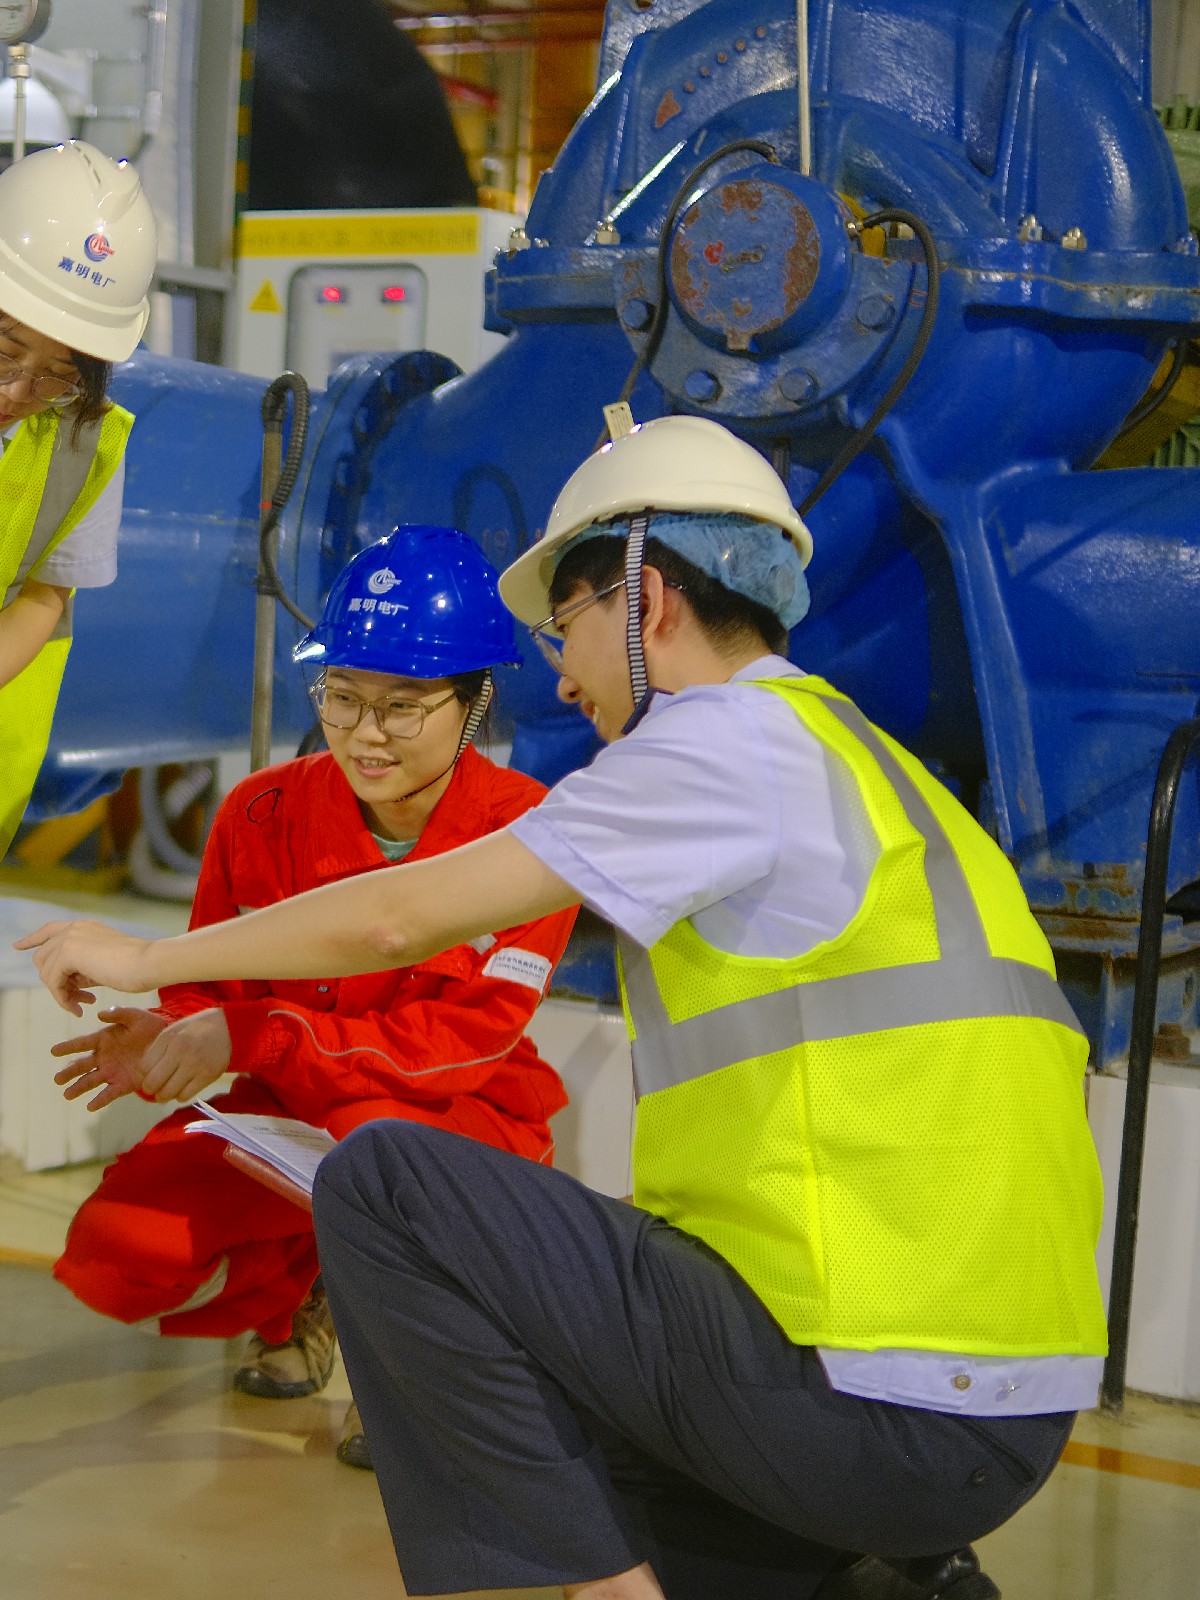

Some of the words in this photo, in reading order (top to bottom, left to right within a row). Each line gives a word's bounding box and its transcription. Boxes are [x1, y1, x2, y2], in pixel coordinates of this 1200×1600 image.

[58, 256, 116, 287] 嘉明电厂
[348, 598, 409, 615] 嘉明电厂
